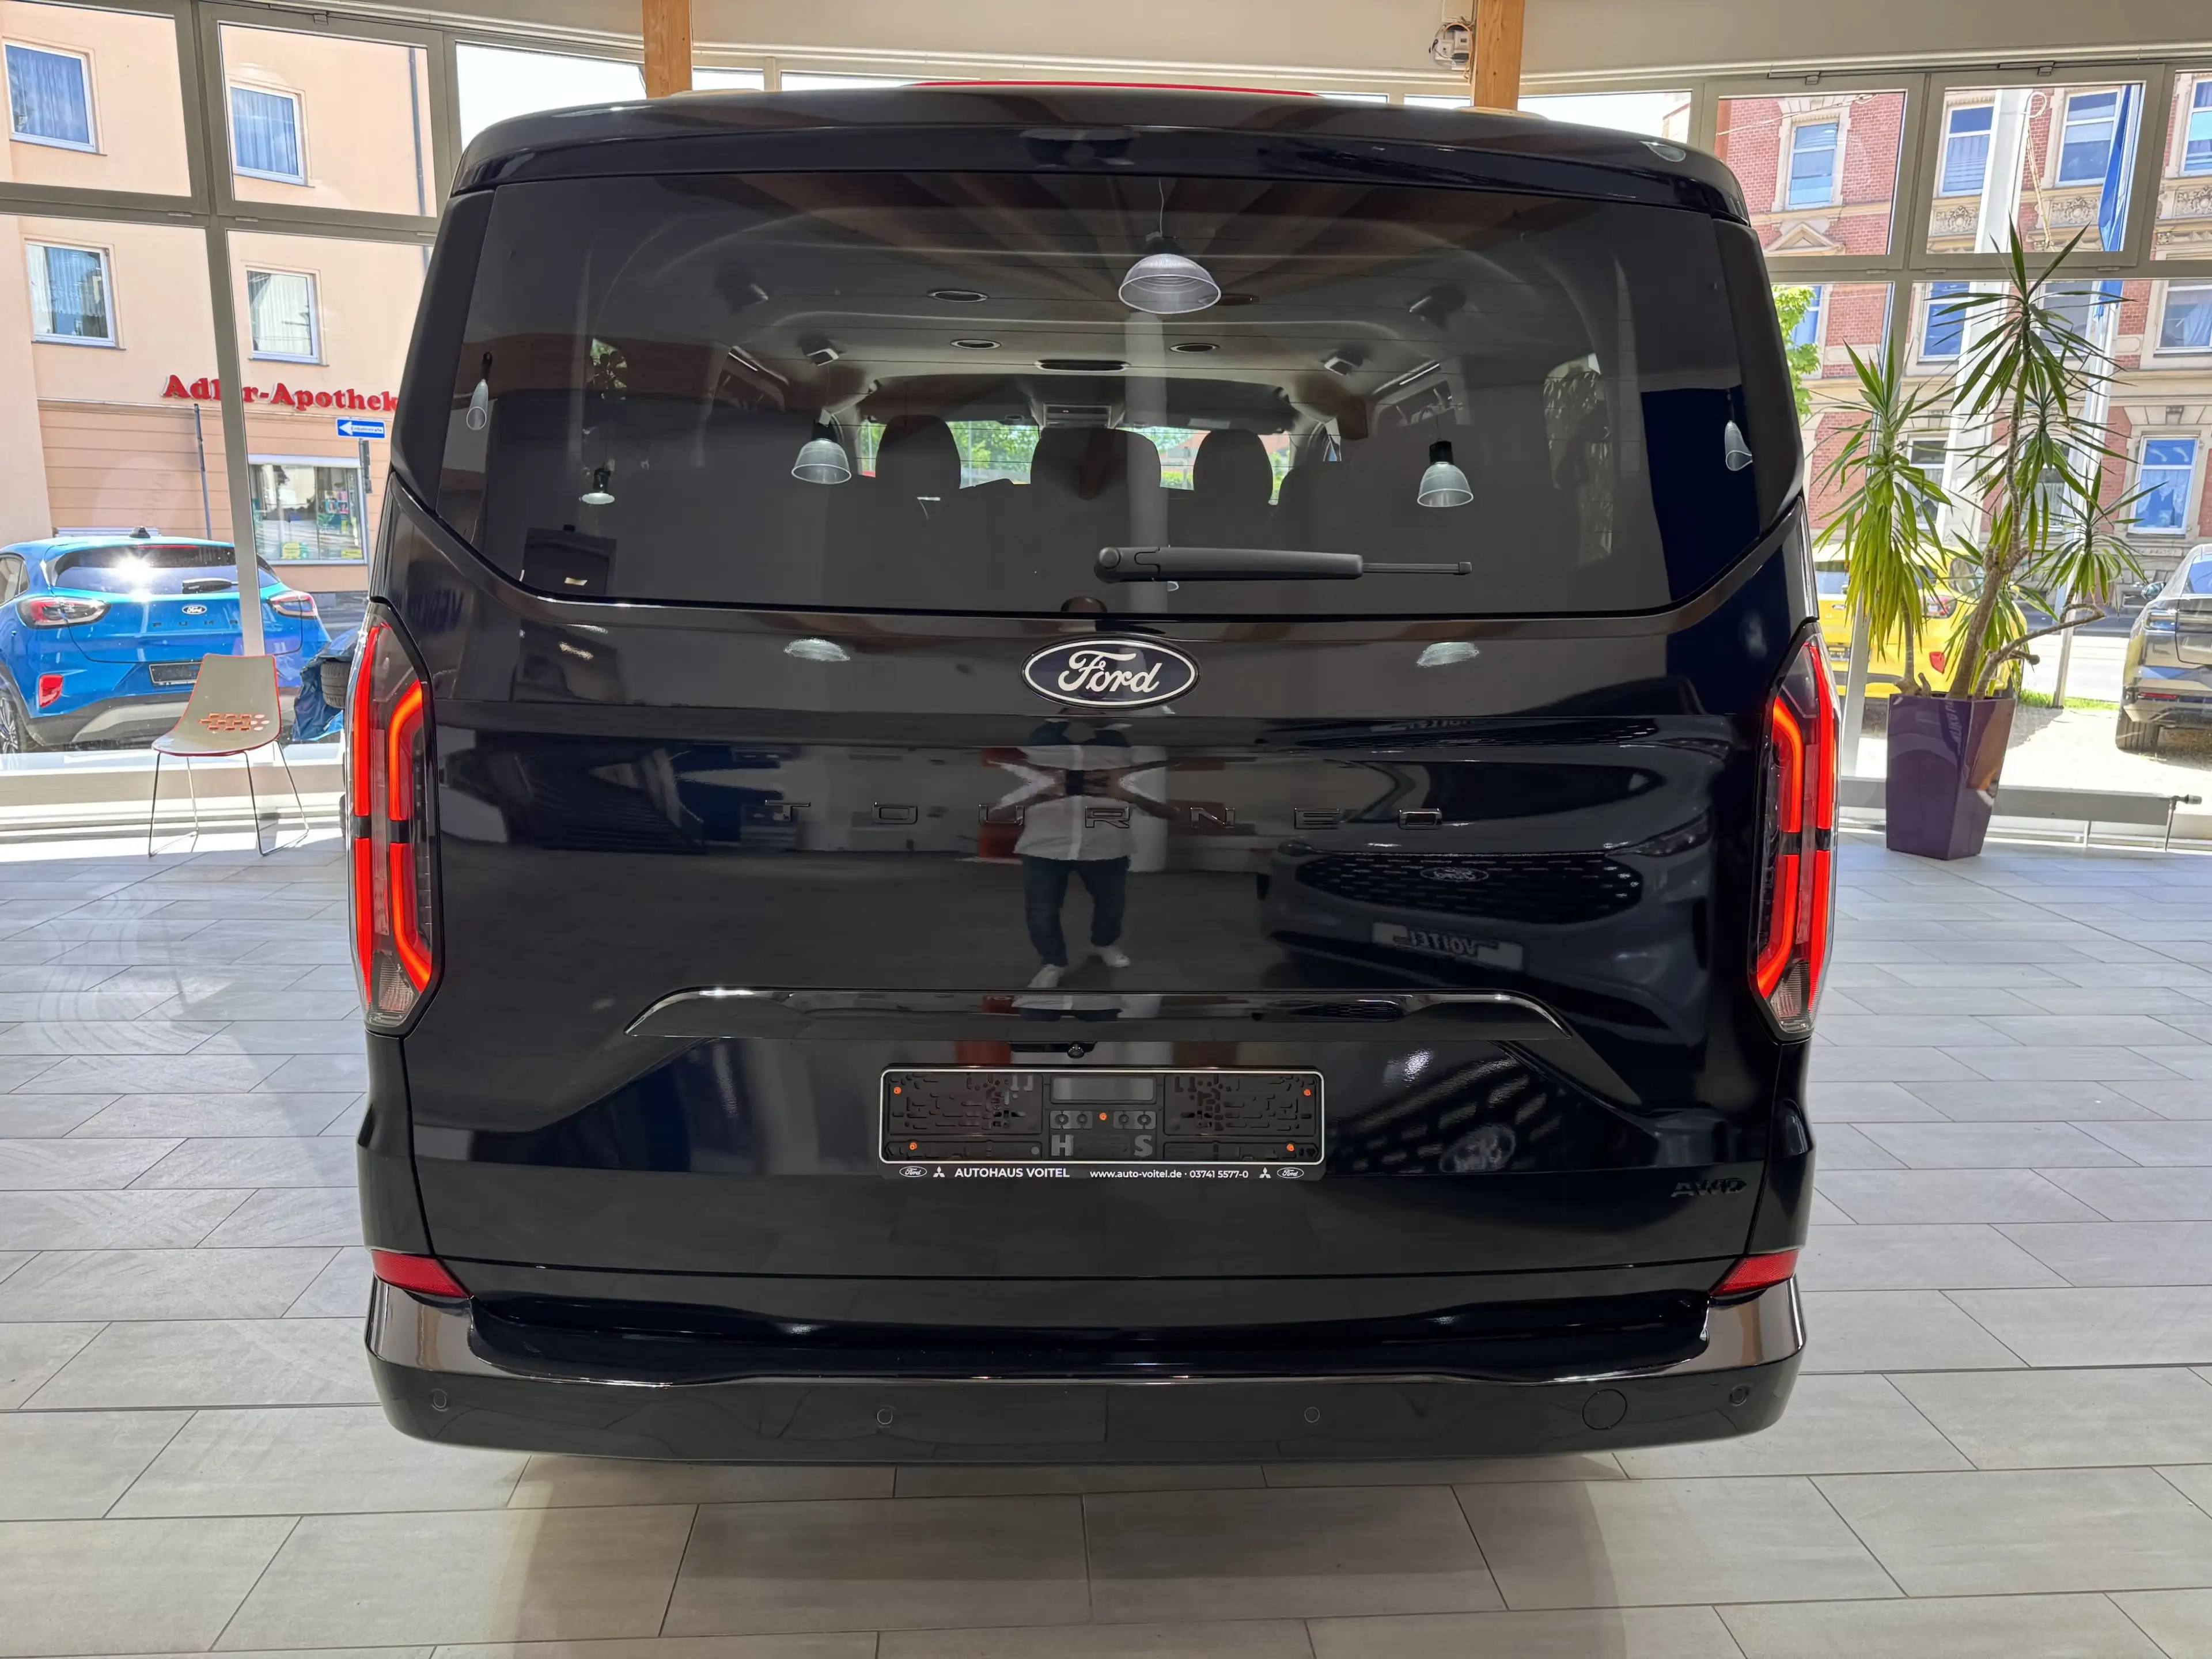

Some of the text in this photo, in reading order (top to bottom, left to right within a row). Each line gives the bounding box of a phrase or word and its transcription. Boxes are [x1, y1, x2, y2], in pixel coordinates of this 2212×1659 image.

[153, 619, 238, 627] PUMA
[1057, 649, 1164, 695] Ford
[764, 798, 1444, 830] TOURNEO
[954, 1168, 1070, 1177] AUTOHAUS VOITEL
[1089, 1169, 1249, 1179] www.auto-voitel.de 03741 5577-0
[1670, 1177, 1748, 1198] AWD
